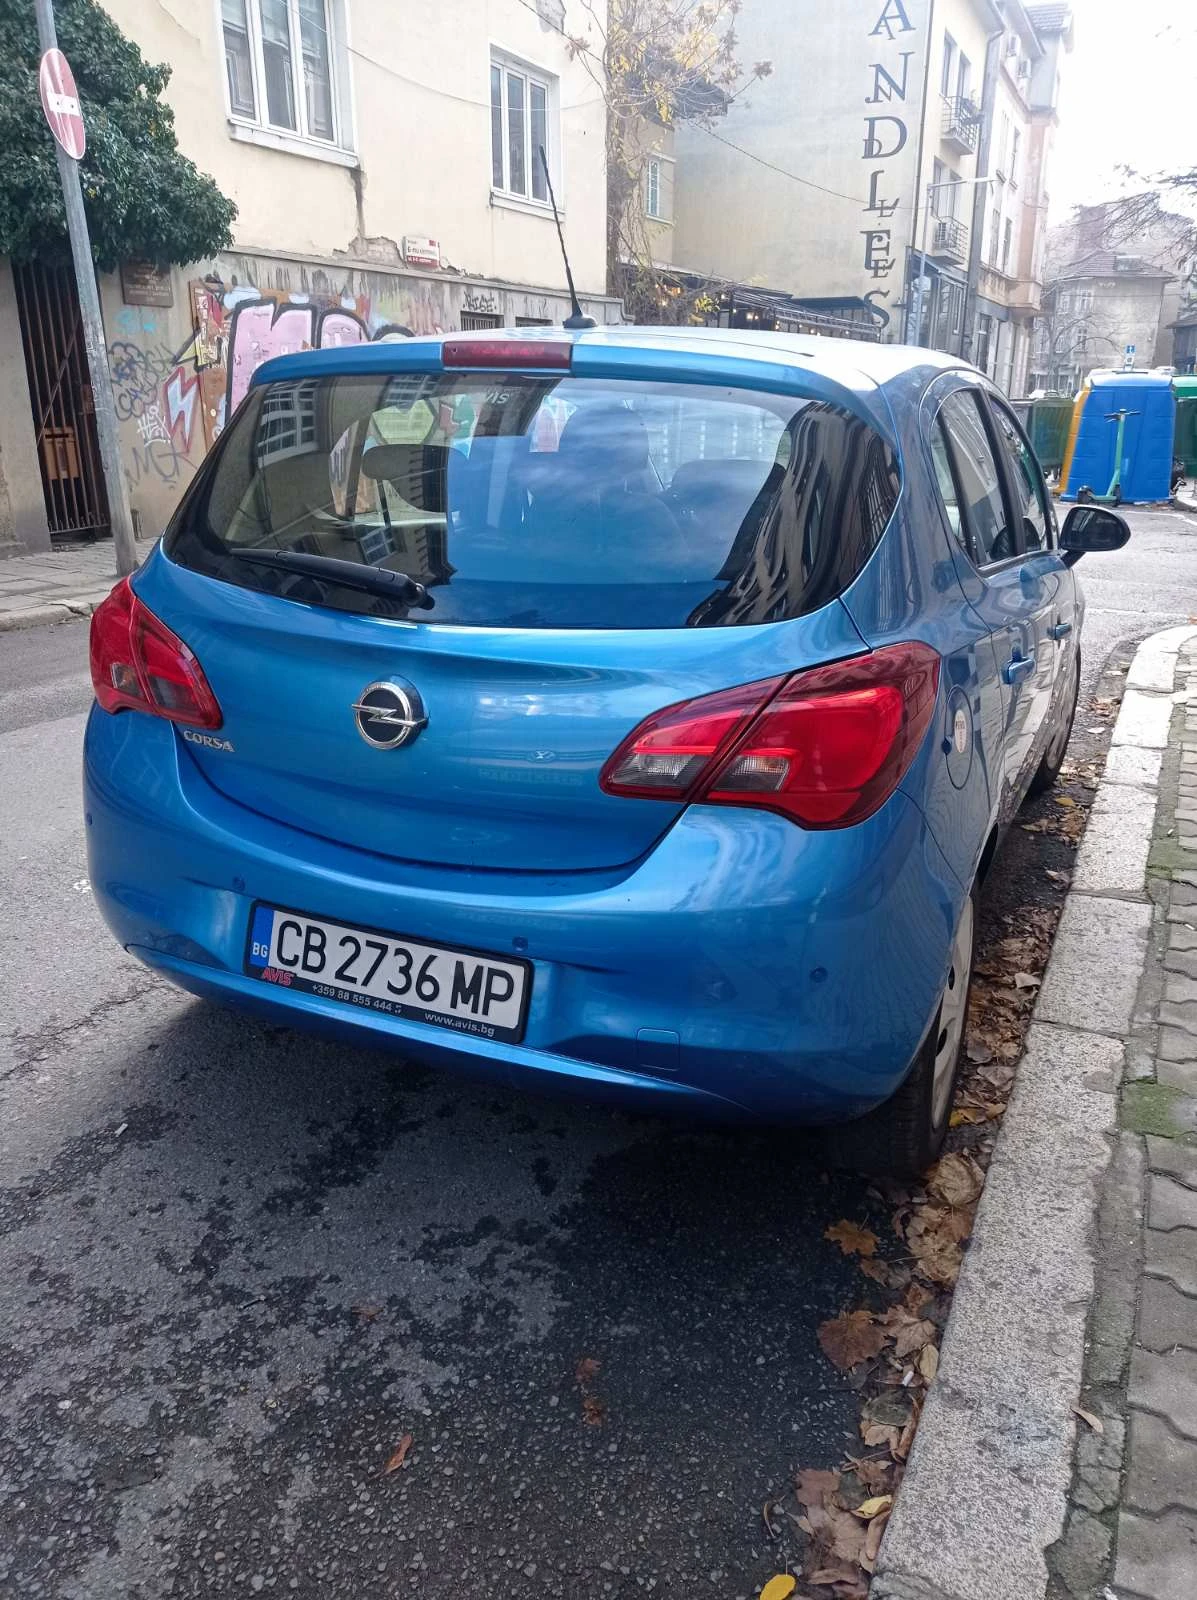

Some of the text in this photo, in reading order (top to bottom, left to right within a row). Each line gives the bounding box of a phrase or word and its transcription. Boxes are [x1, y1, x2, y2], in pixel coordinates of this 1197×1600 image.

[184, 731, 235, 752] CORSA
[252, 942, 269, 958] BG
[261, 967, 295, 986] AVIS
[276, 921, 514, 1016] CB 2736 MP
[312, 984, 335, 996] +359
[337, 990, 350, 1000] 88
[352, 995, 371, 1006] 555
[373, 1000, 392, 1012] 444
[425, 1012, 495, 1036] www.avis.bg
